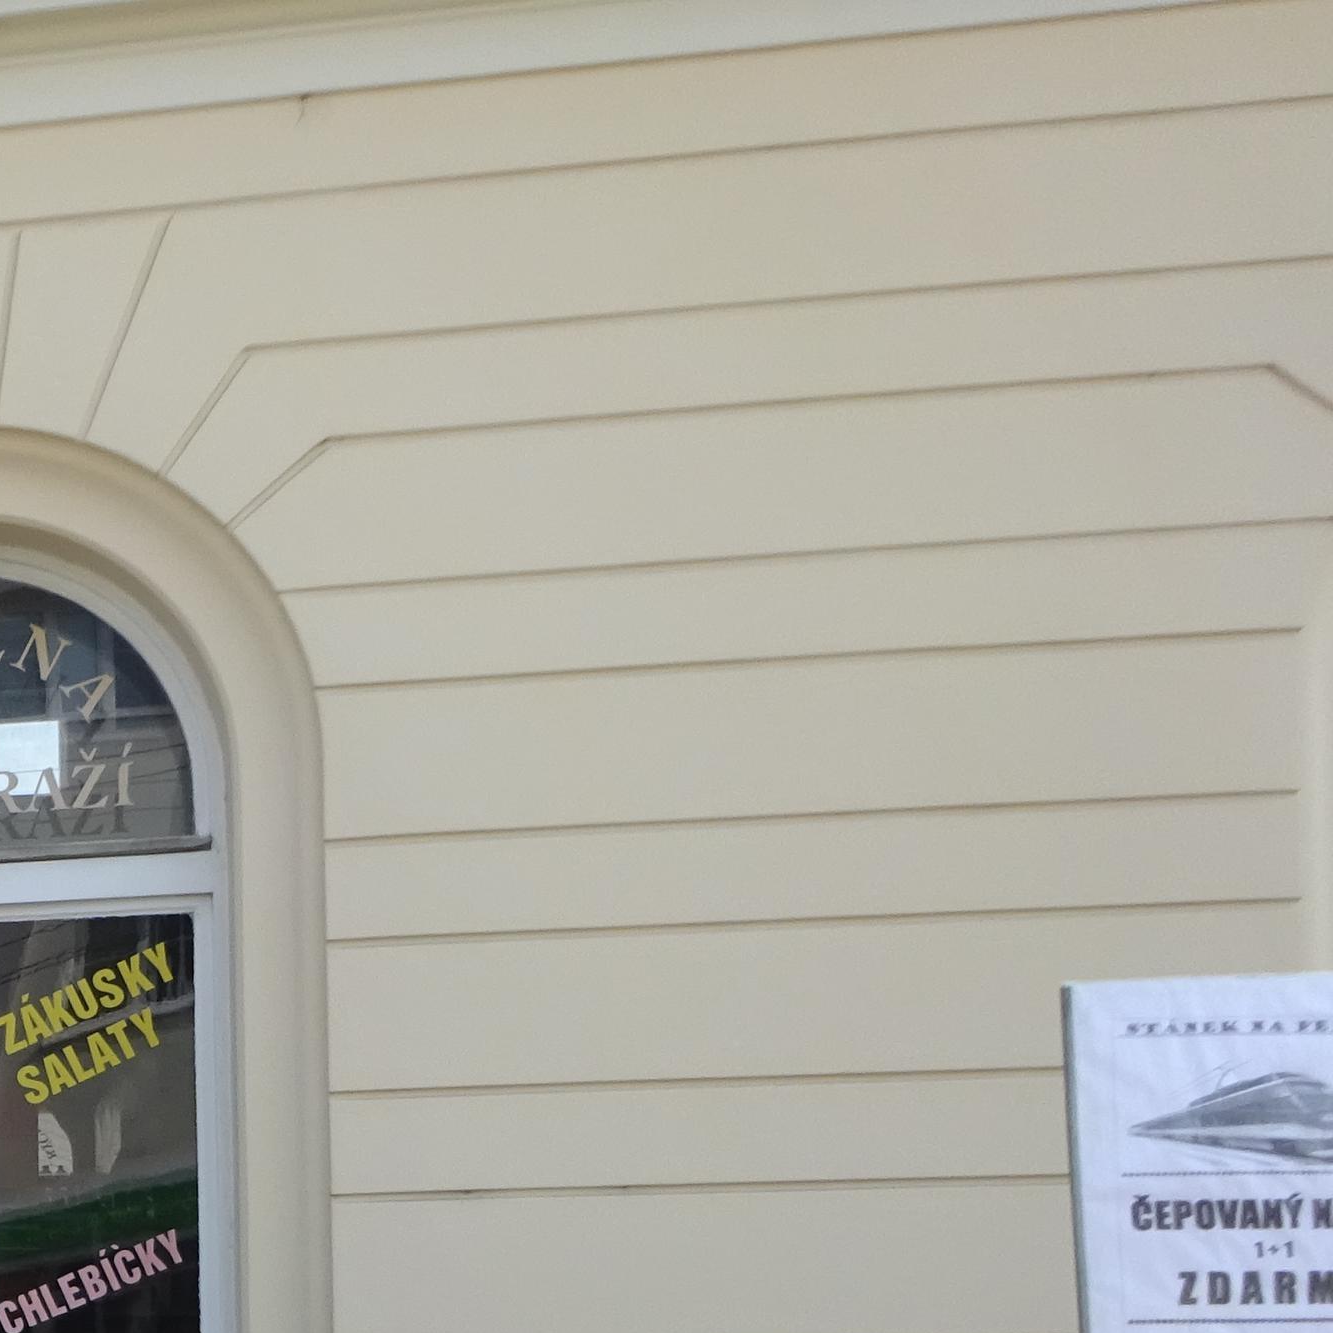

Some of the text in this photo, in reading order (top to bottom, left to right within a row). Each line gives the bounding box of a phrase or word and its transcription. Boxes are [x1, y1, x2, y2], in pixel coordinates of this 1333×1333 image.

[17, 1007, 160, 1104] SALATY
[1131, 1193, 1303, 1230] ČEPOVANÝ
[1254, 1241, 1294, 1258] 1+1
